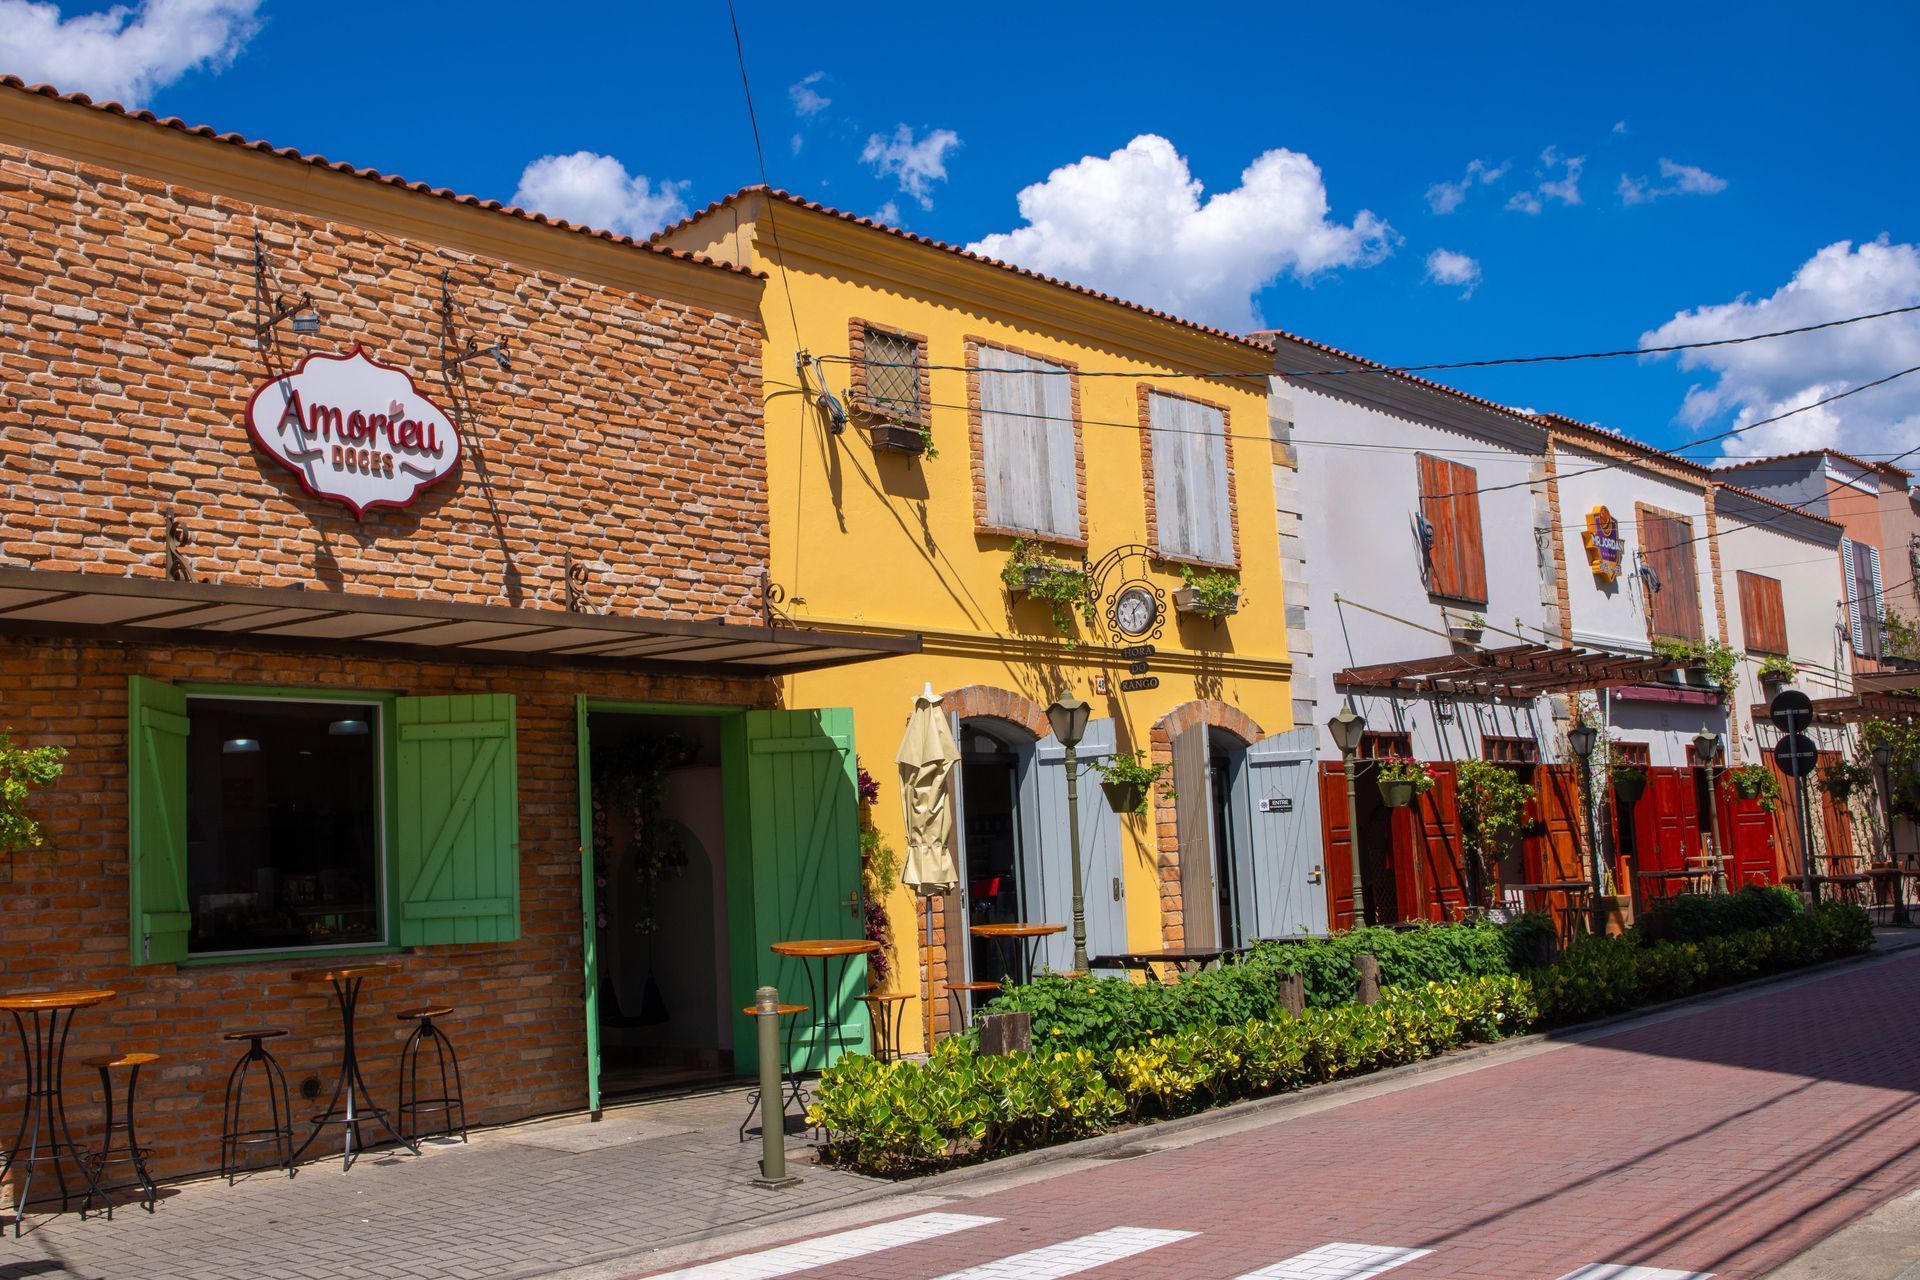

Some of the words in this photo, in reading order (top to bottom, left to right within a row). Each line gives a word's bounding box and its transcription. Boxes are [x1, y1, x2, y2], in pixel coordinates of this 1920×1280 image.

[277, 389, 443, 454] Amorieu
[331, 444, 394, 473] DOCES
[1124, 647, 1152, 658] HORA
[1132, 664, 1146, 673] DO
[1122, 678, 1158, 690] RANGO
